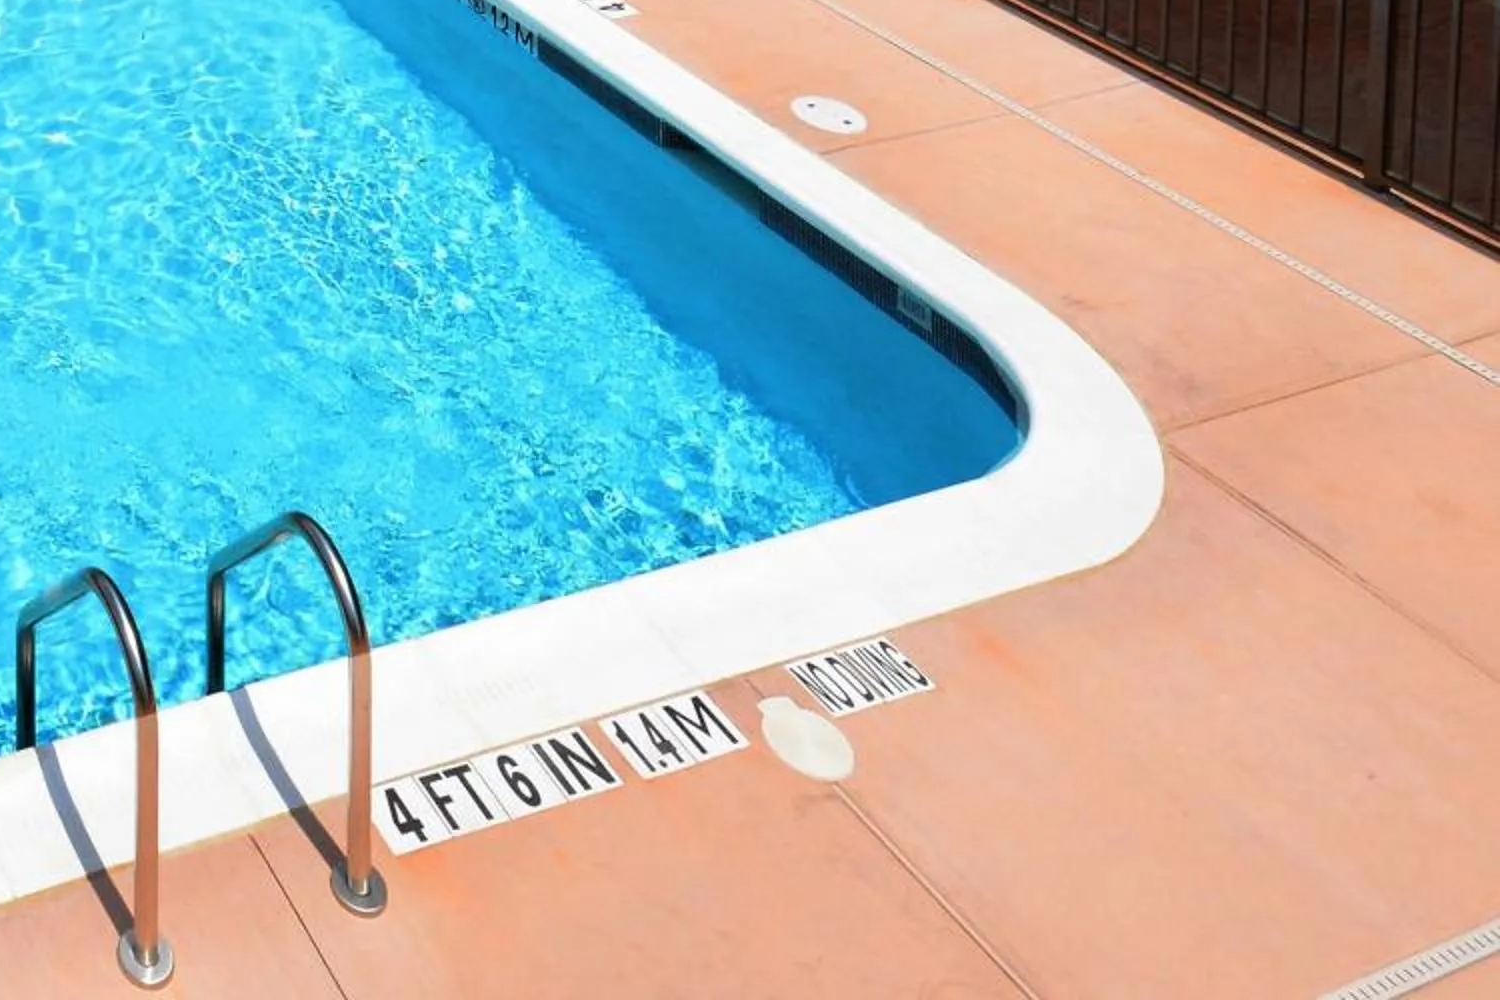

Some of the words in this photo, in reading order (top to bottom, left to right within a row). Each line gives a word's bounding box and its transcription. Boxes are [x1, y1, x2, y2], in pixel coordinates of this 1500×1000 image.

[789, 661, 855, 713] NO
[824, 640, 930, 703] DIVING
[385, 786, 428, 842] 4
[419, 763, 494, 830] FT
[496, 754, 542, 807] 6
[532, 731, 616, 796] IN
